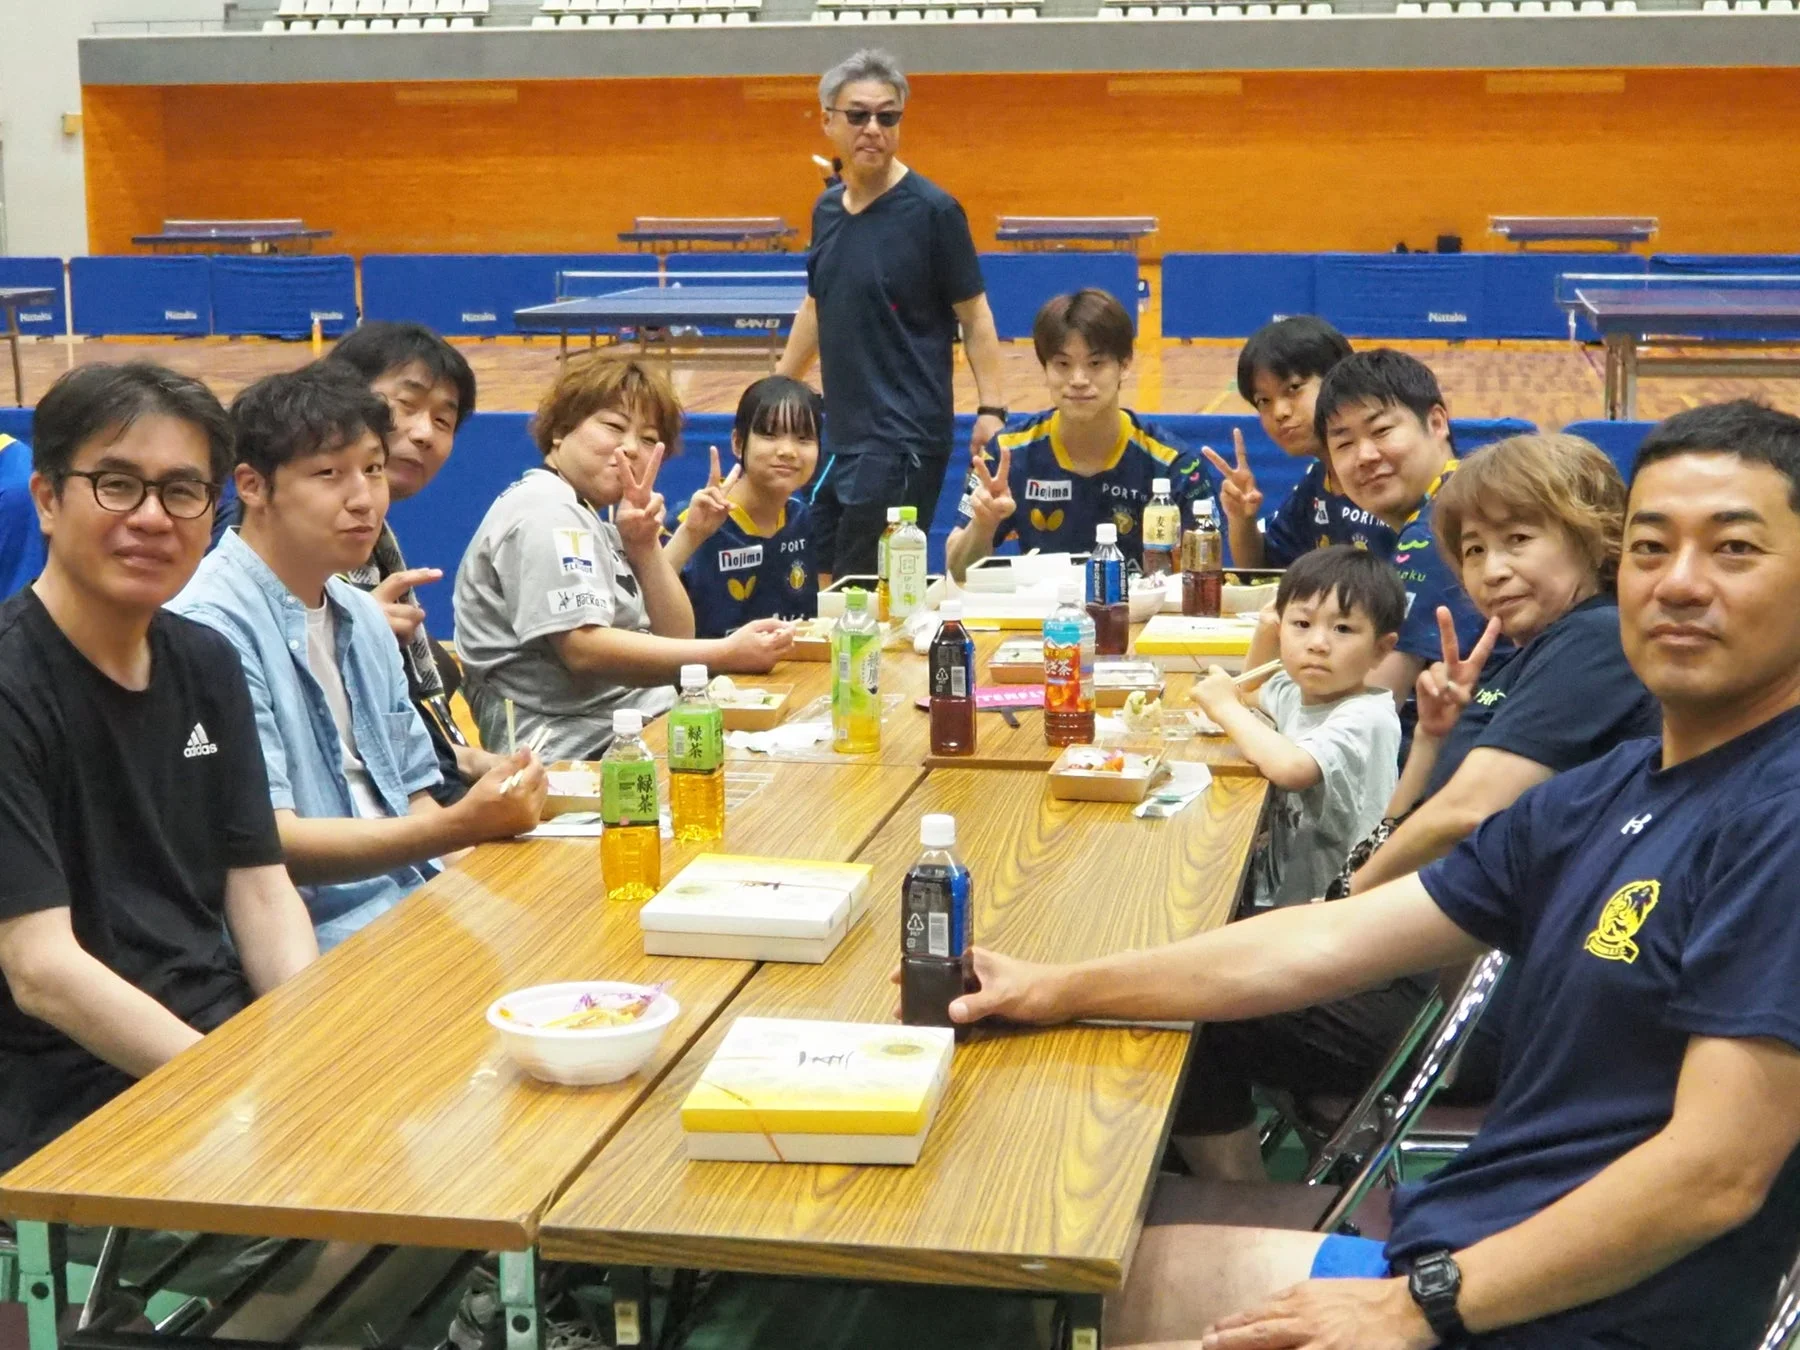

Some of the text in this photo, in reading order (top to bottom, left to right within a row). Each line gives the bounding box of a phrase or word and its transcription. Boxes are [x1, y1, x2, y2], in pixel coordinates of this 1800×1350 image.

[1102, 483, 1139, 500] PORT
[780, 539, 806, 552] PORT
[183, 743, 218, 758] adidas
[688, 725, 703, 759] 緑茶
[637, 773, 653, 813] 緑茶
